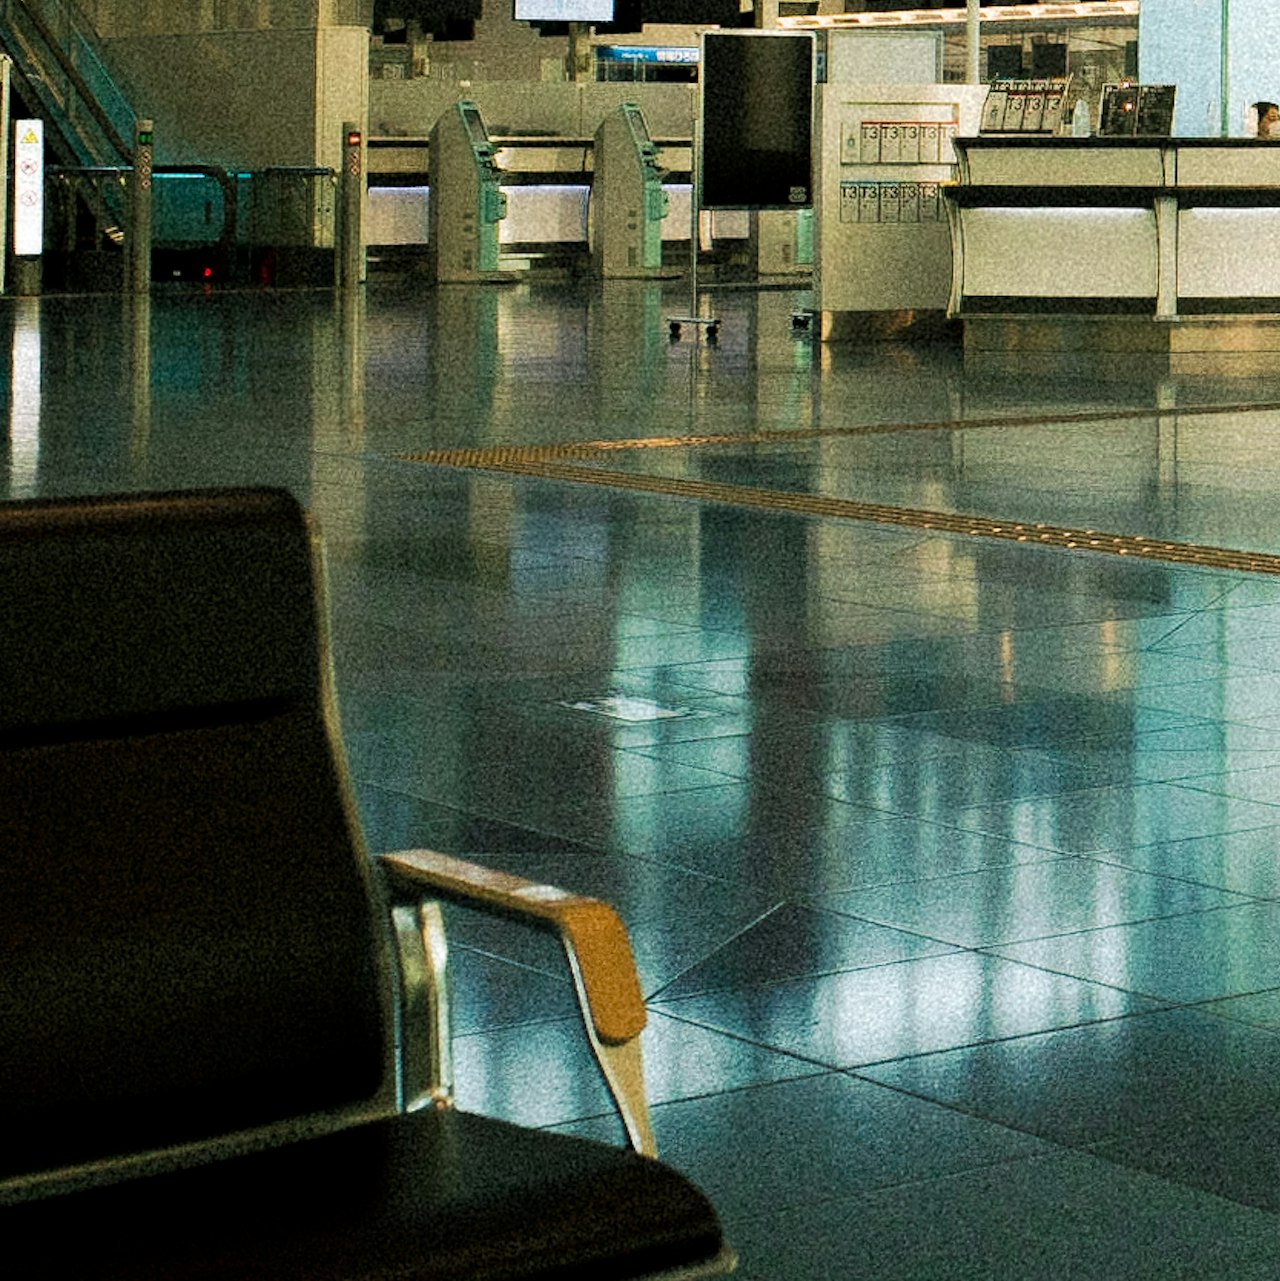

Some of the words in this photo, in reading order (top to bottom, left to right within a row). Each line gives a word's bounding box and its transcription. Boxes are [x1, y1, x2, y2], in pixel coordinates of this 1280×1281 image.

[882, 126, 899, 140] T3
[901, 126, 918, 140] T3
[841, 185, 857, 199] T3
[860, 185, 877, 199] T3
